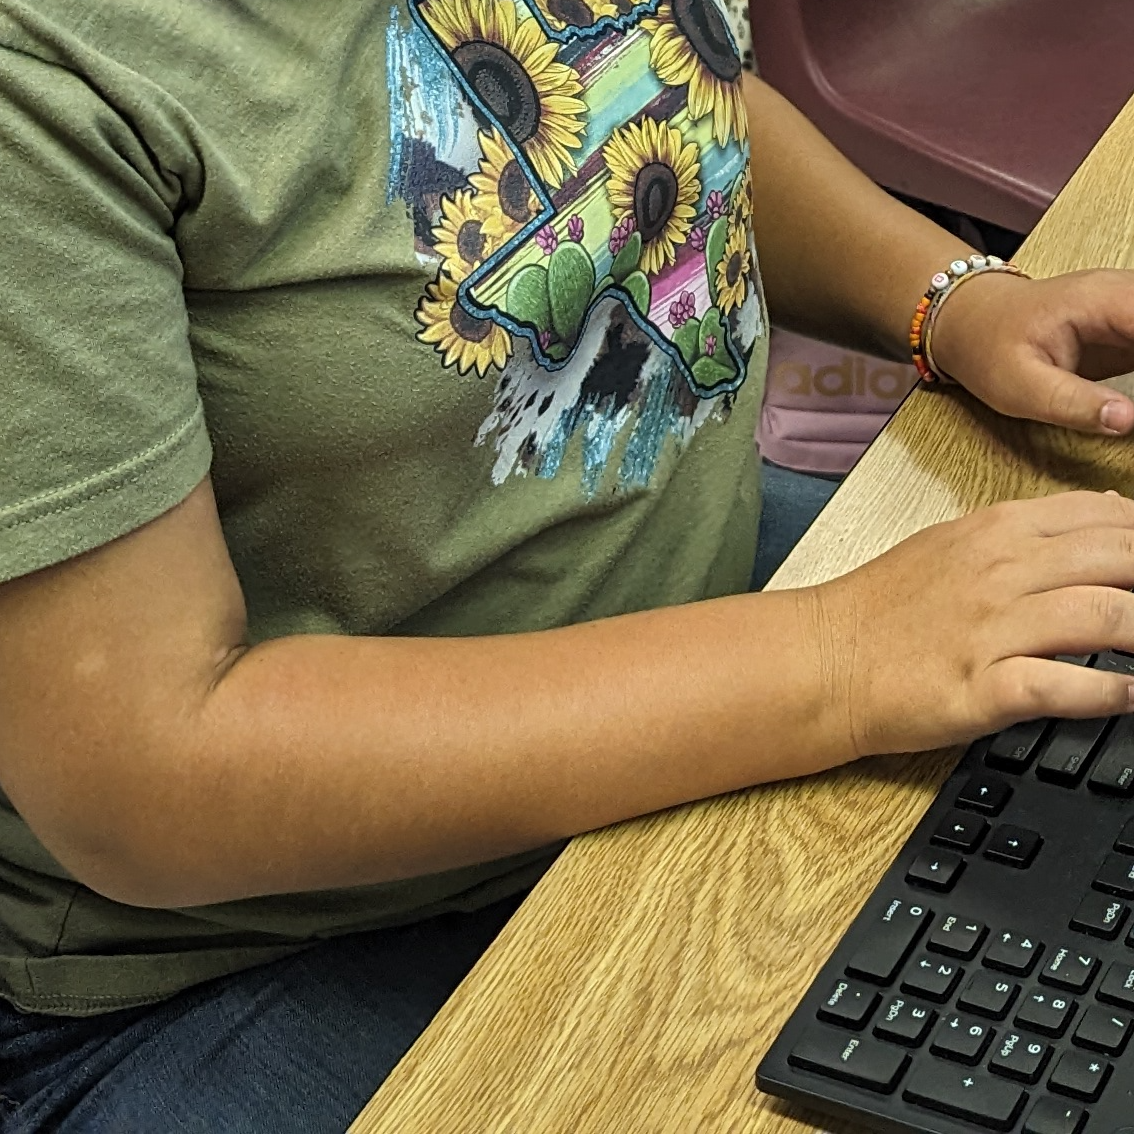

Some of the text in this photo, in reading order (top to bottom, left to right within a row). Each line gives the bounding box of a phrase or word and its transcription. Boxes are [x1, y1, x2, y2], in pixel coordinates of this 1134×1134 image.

[774, 355, 908, 399] adid
[1118, 768, 1132, 785] Enter
[883, 900, 901, 920] Insert
[910, 907, 922, 915] 0
[1103, 903, 1120, 923] PgDn
[943, 917, 956, 931] End
[1021, 939, 1032, 948] 4
[1051, 949, 1068, 970] Home
[1079, 957, 1090, 965] 7
[938, 966, 951, 974] 2
[828, 983, 847, 1005] Delete
[996, 983, 1008, 992] 5
[886, 1000, 904, 1020] PgDn
[1053, 1000, 1065, 1008] 8
[912, 1009, 925, 1017] 3
[970, 1026, 982, 1035] 6
[842, 1040, 859, 1060] Enter
[1001, 1035, 1019, 1056] PgUp
[1028, 1044, 1040, 1053] 9
